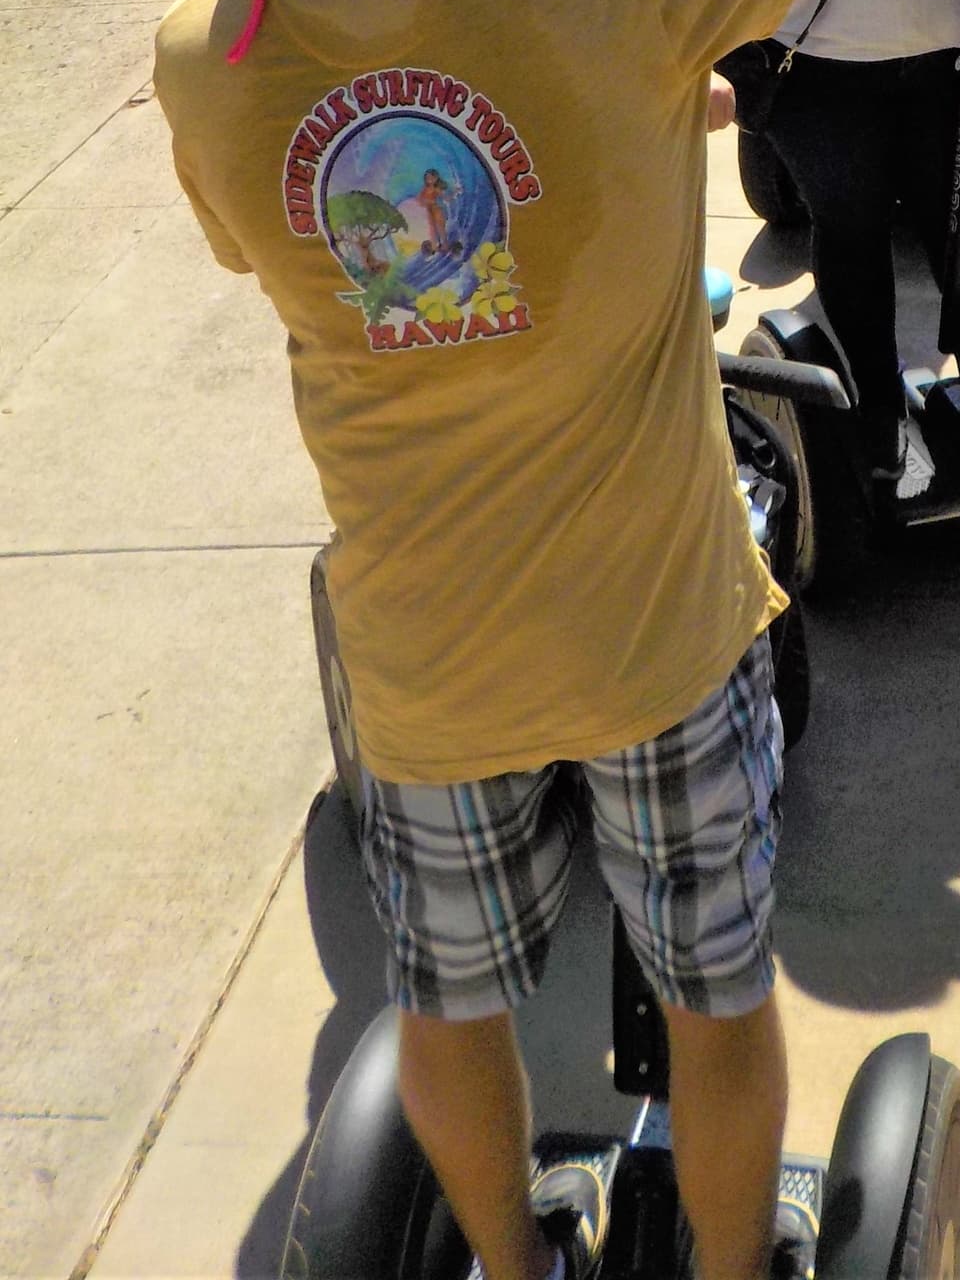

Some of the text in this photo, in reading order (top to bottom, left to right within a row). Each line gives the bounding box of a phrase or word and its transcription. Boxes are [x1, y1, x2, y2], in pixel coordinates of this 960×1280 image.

[285, 70, 541, 235] SIDEWALK SURFING TOURS
[366, 304, 532, 350] HAWAII
